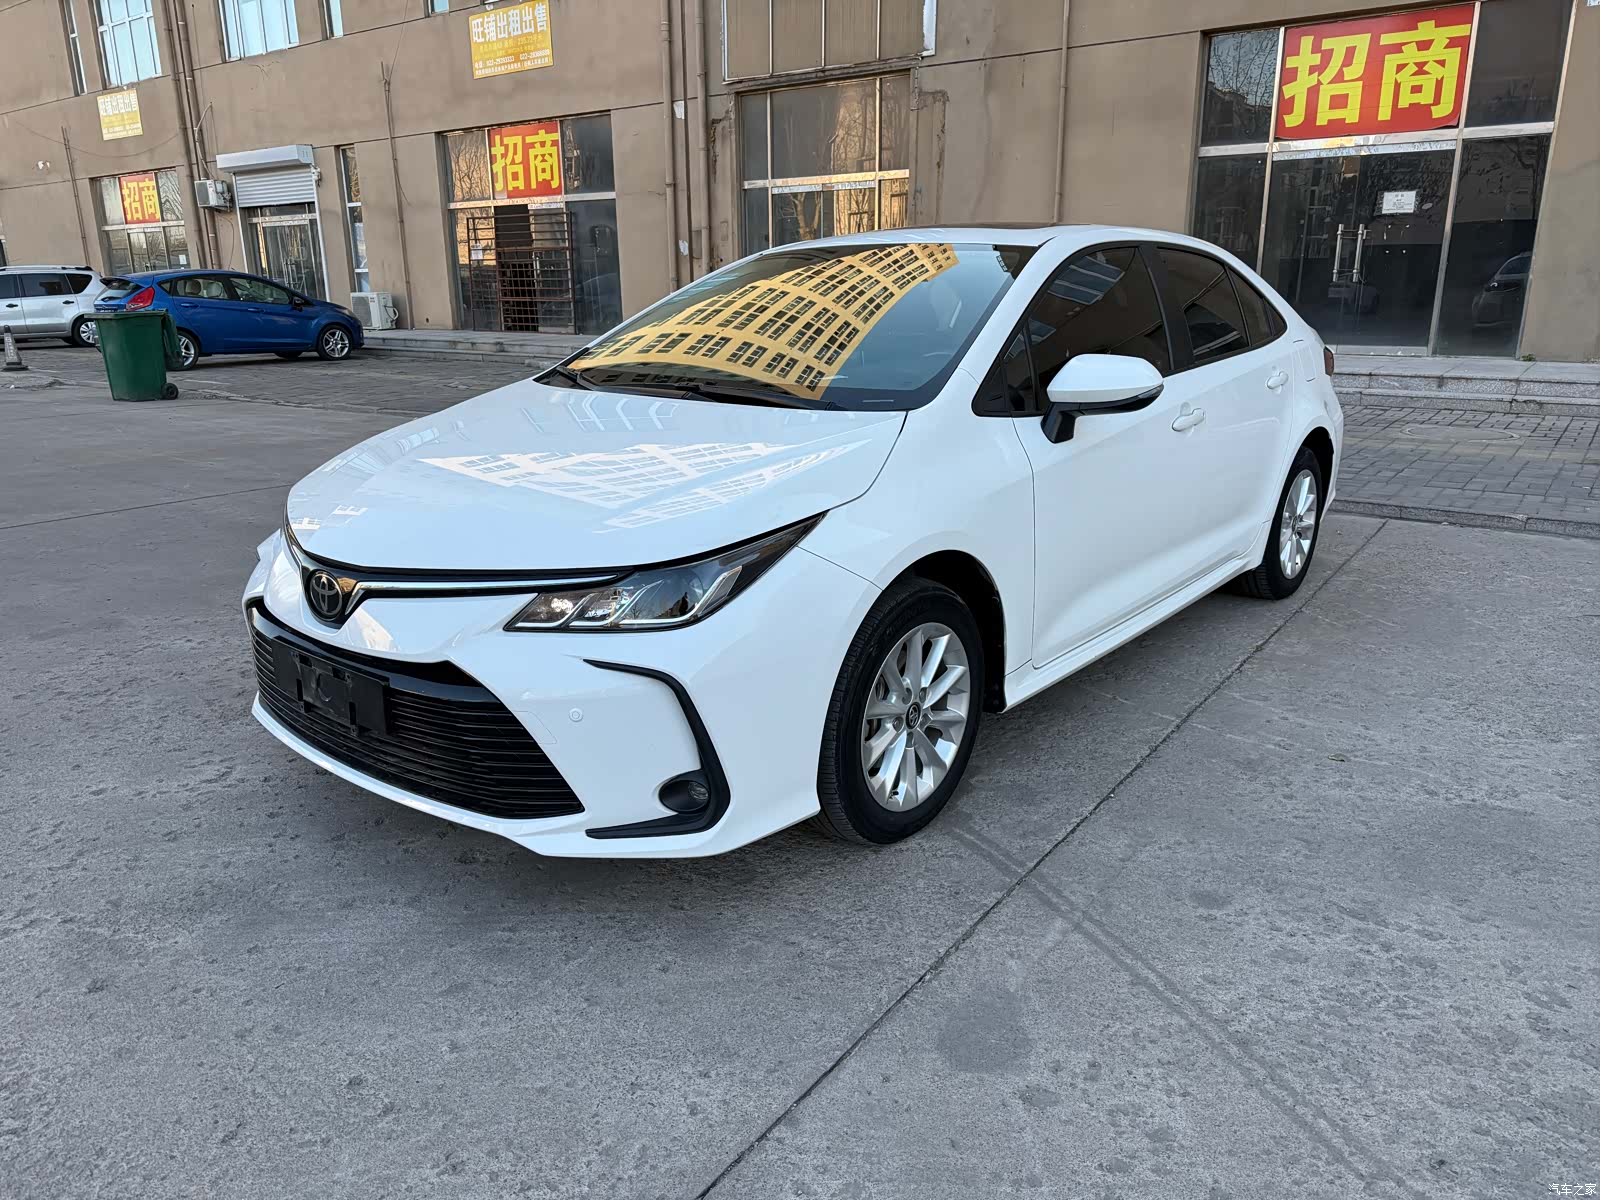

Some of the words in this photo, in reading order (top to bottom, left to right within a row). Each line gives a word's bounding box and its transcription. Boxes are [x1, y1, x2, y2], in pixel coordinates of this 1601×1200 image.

[471, 3, 547, 43] 旺铺出租出售
[1282, 20, 1472, 128] 招商
[491, 129, 560, 192] 招商
[122, 178, 160, 221] 招商
